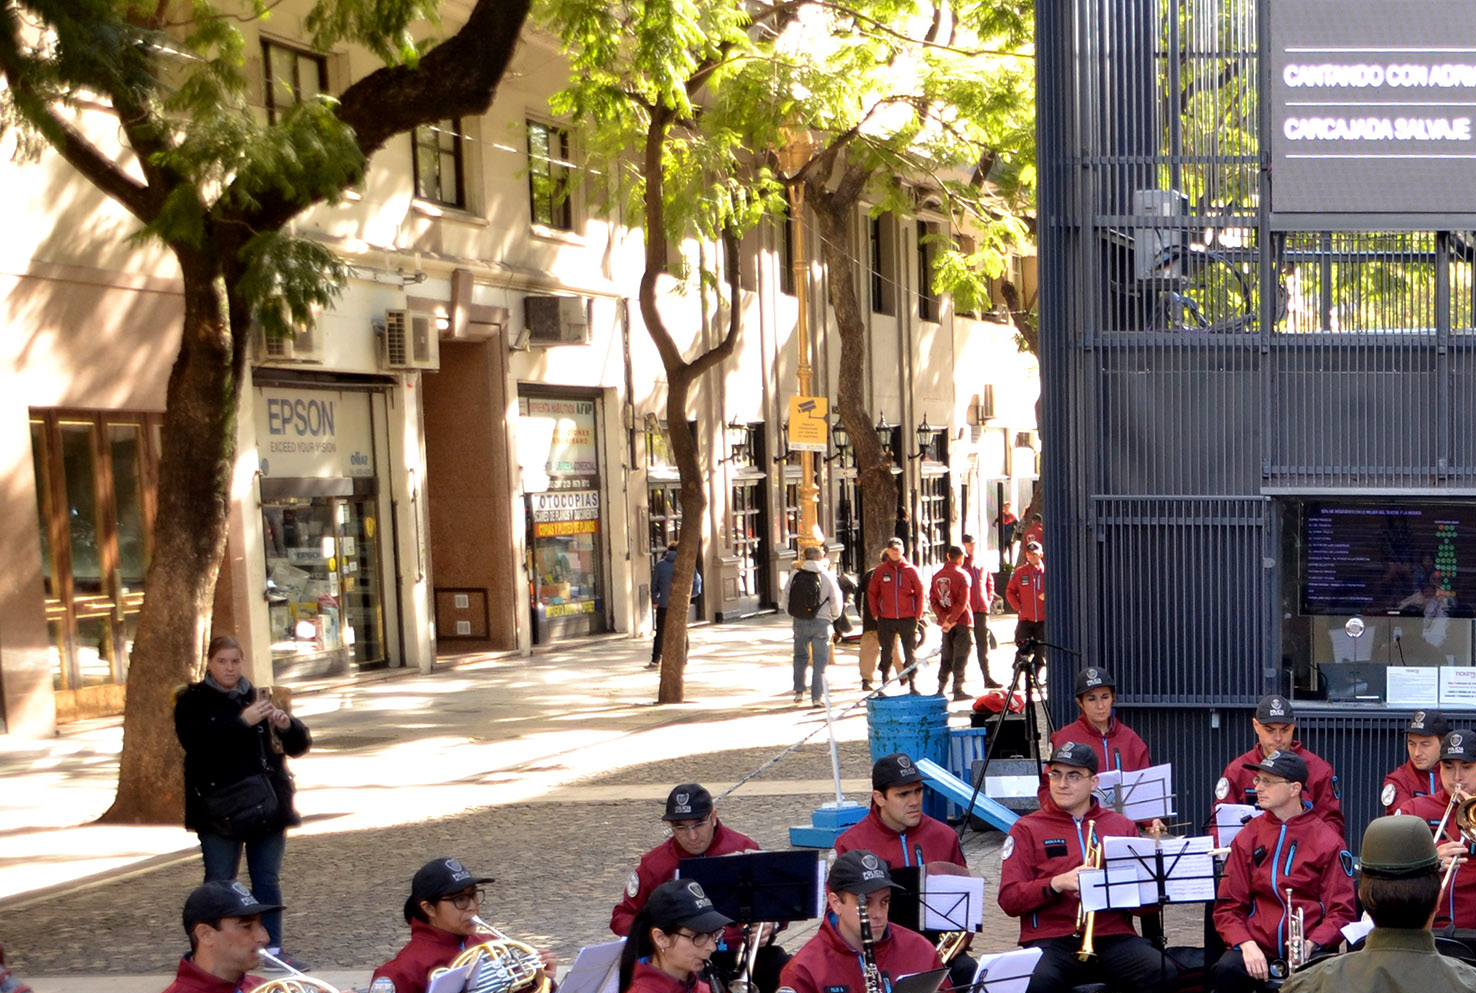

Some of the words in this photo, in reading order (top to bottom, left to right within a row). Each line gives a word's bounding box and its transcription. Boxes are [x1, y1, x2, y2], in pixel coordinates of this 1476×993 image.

[1283, 64, 1384, 87] CANTANDO
[1386, 64, 1428, 87] CON
[1284, 117, 1394, 140] CARCAJADA
[1395, 117, 1471, 140] SALVAJE
[267, 399, 335, 436] EPSON
[270, 441, 296, 453] EXCEED
[298, 442, 314, 453] YOUR
[534, 493, 598, 508] OTOCOPIAS
